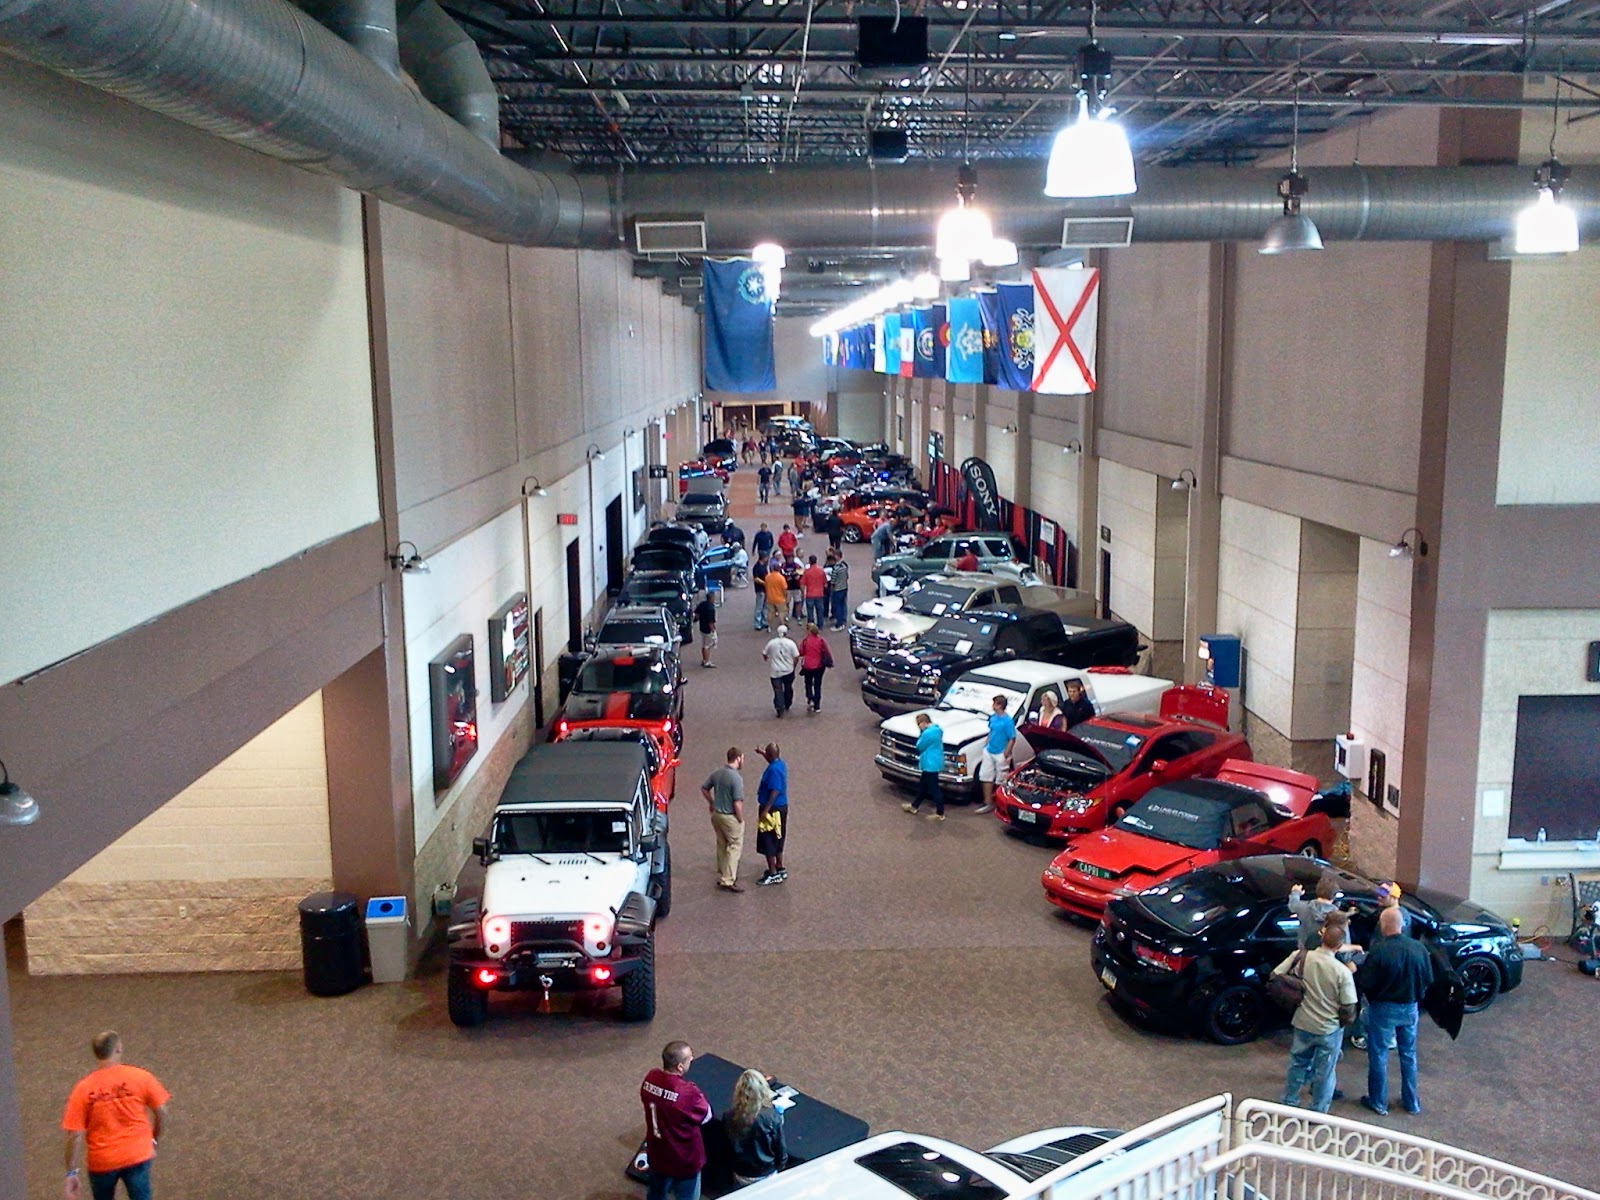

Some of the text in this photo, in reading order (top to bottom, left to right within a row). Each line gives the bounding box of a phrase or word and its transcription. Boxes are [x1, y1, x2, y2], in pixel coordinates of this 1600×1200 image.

[970, 465, 997, 516] SONY
[1080, 862, 1099, 877] CAPRI
[663, 1089, 679, 1102] TIDE
[649, 1102, 662, 1138] 1
